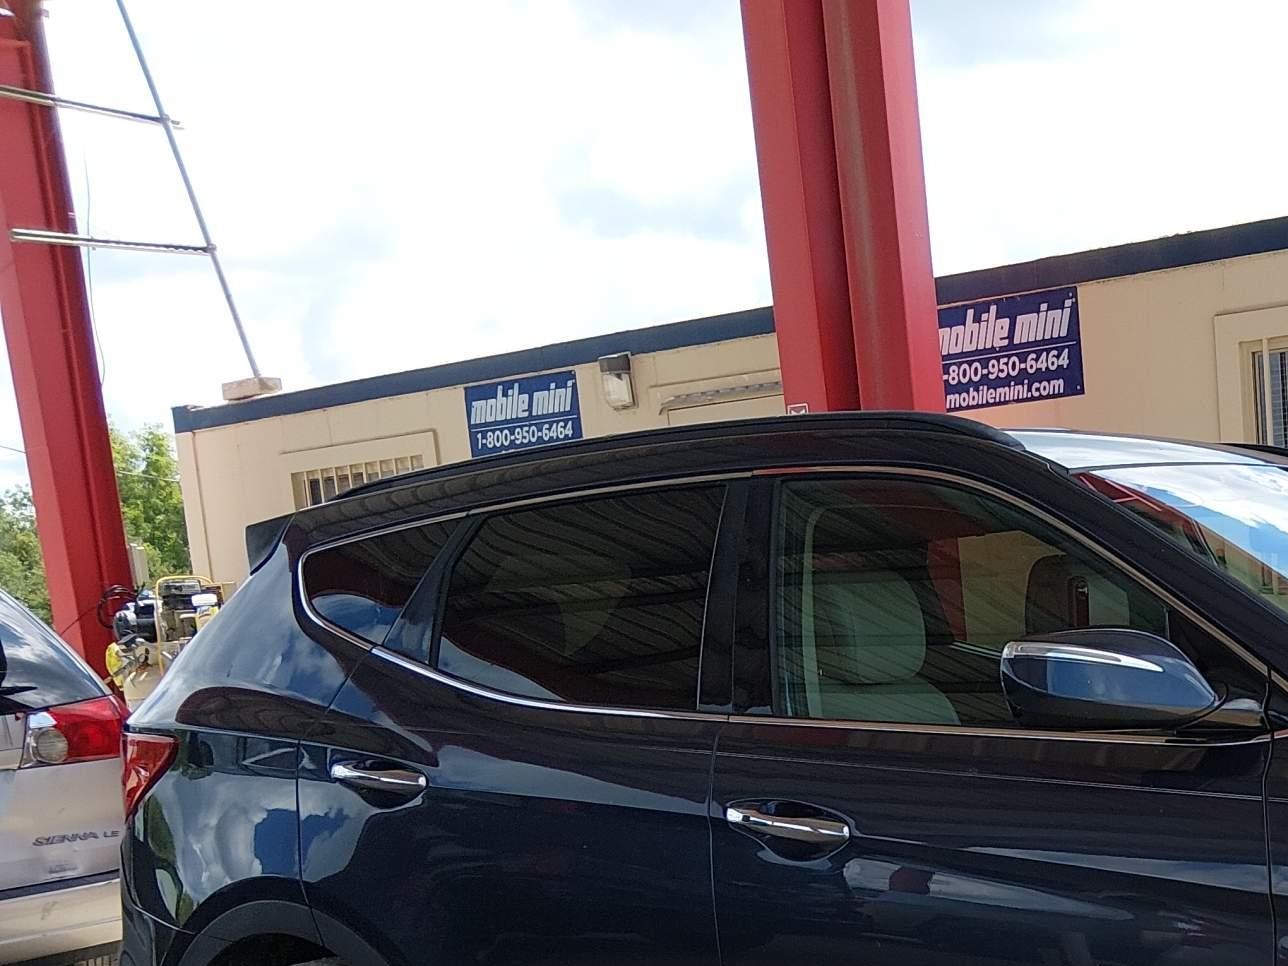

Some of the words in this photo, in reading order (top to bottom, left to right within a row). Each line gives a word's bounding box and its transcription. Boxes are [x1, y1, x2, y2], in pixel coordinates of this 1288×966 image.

[1013, 299, 1072, 344] mini
[943, 348, 1069, 385] -800-950-6464
[470, 382, 529, 425] mobile
[532, 380, 573, 416] mini
[946, 378, 1064, 409] mobilemini.com
[476, 420, 573, 449] 1-800-950-6464
[32, 831, 100, 847] SIENNA
[103, 830, 120, 838] LE
